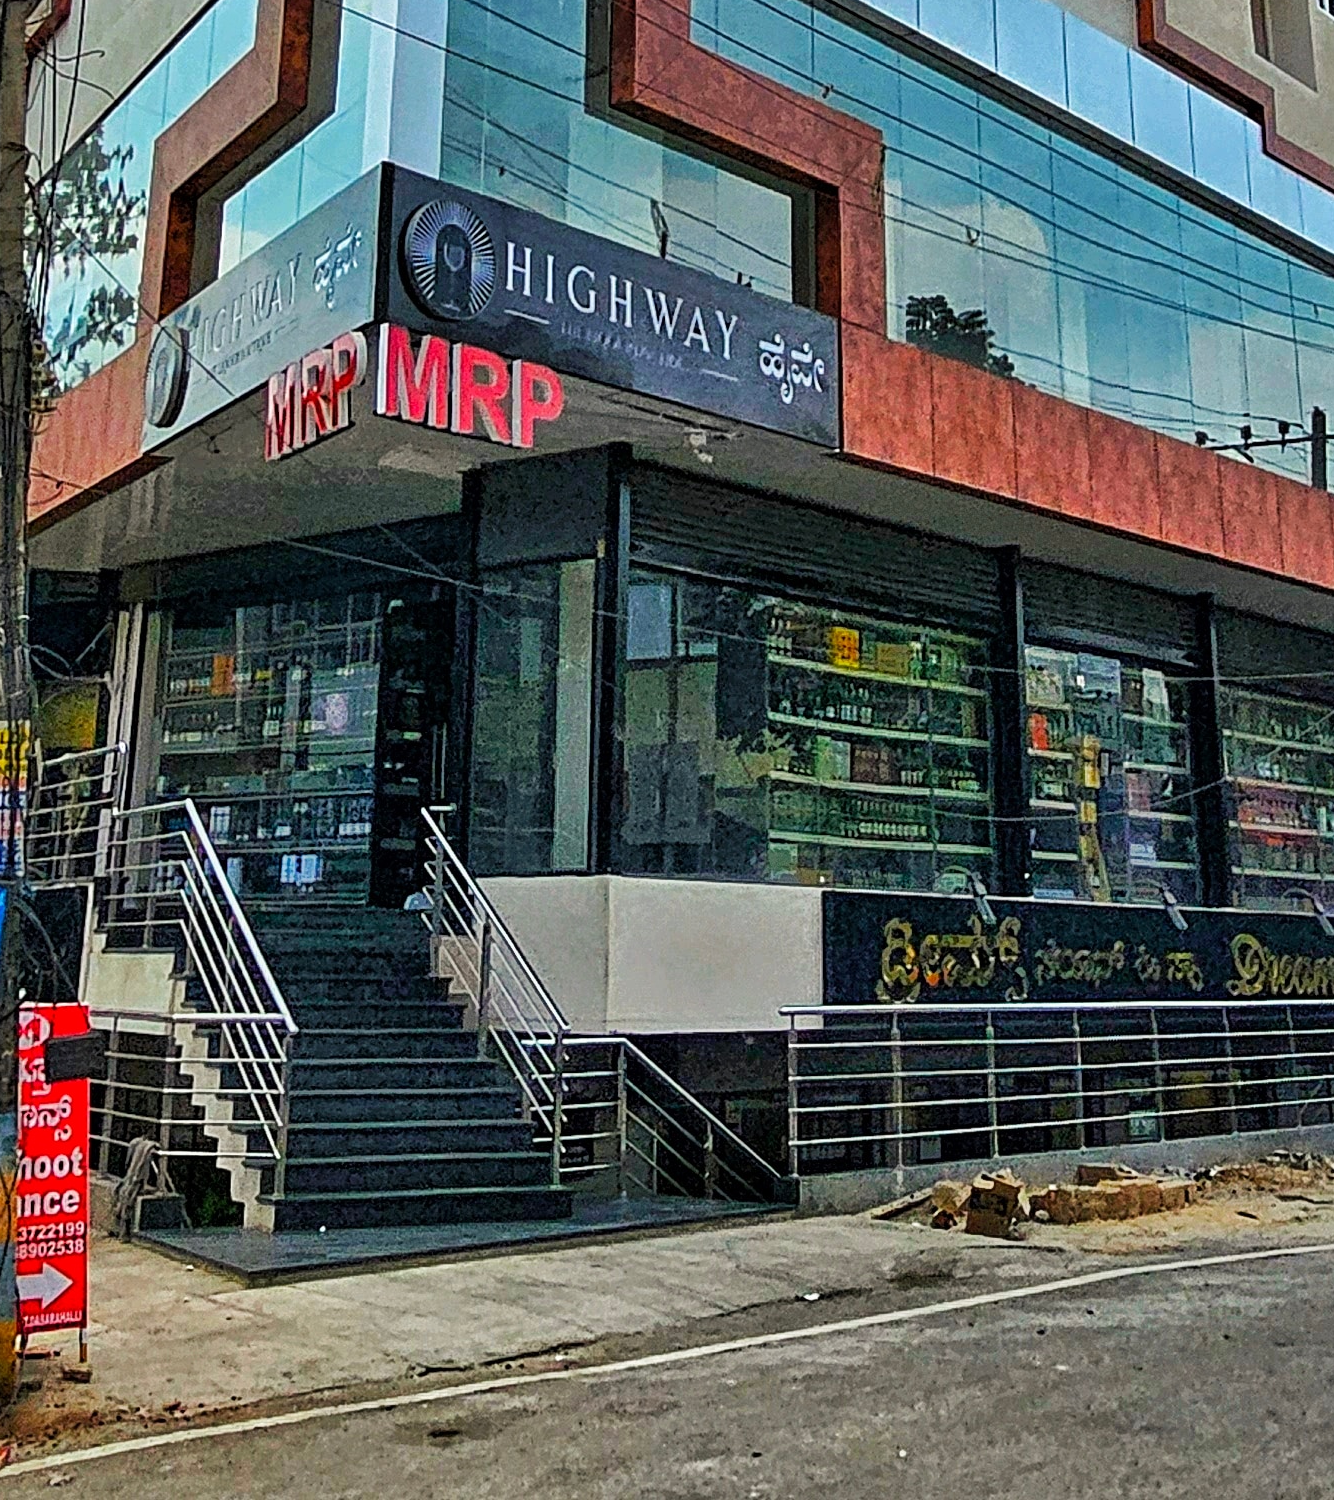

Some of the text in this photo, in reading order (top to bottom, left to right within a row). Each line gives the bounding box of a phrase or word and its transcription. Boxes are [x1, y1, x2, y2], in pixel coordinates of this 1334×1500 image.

[188, 253, 302, 351] HIGHWAY
[506, 242, 738, 360] HIGHWAY
[264, 331, 367, 462] MRP
[377, 322, 566, 449] MRP
